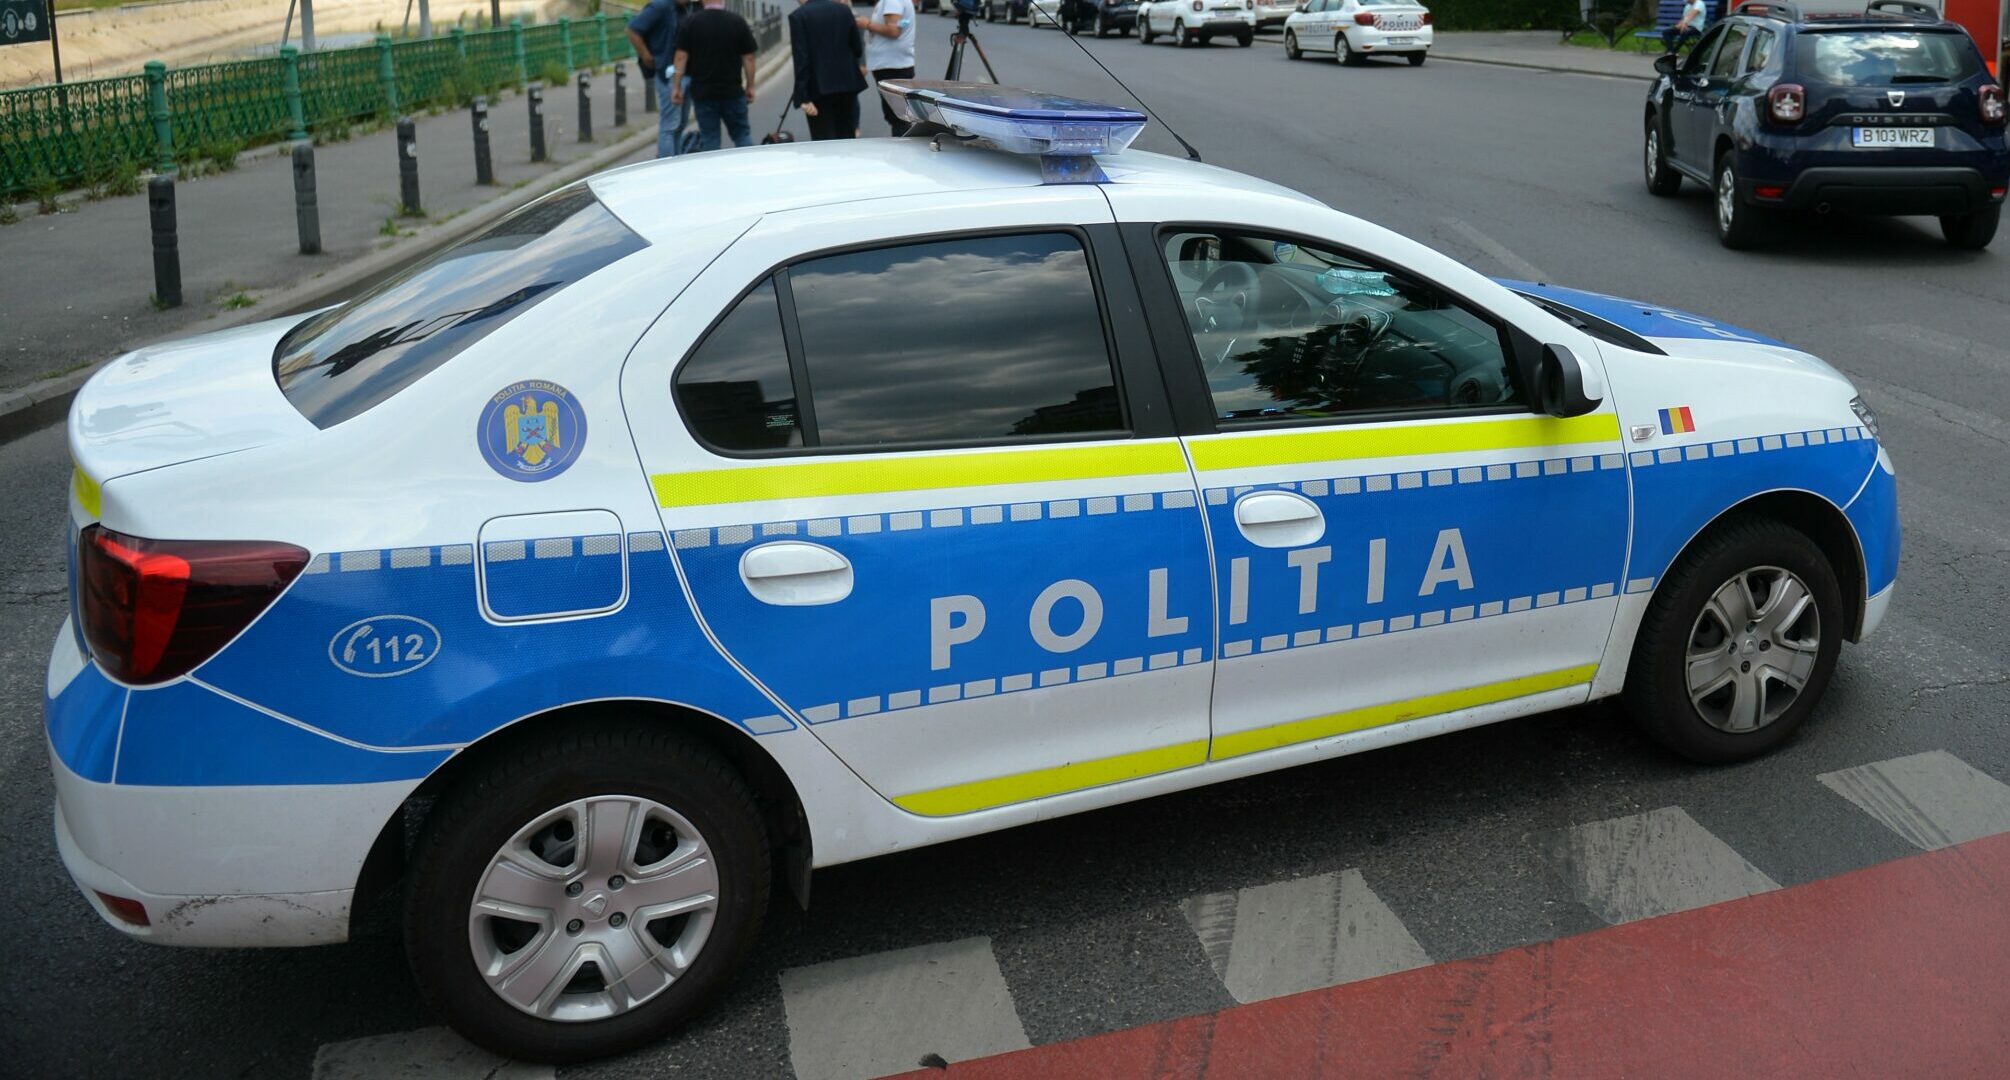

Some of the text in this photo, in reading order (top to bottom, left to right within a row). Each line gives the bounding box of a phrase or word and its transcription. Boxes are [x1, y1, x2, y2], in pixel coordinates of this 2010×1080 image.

[1382, 20, 1418, 28] POLITIA
[930, 527, 1475, 671] POLITIA
[366, 633, 424, 664] 112
